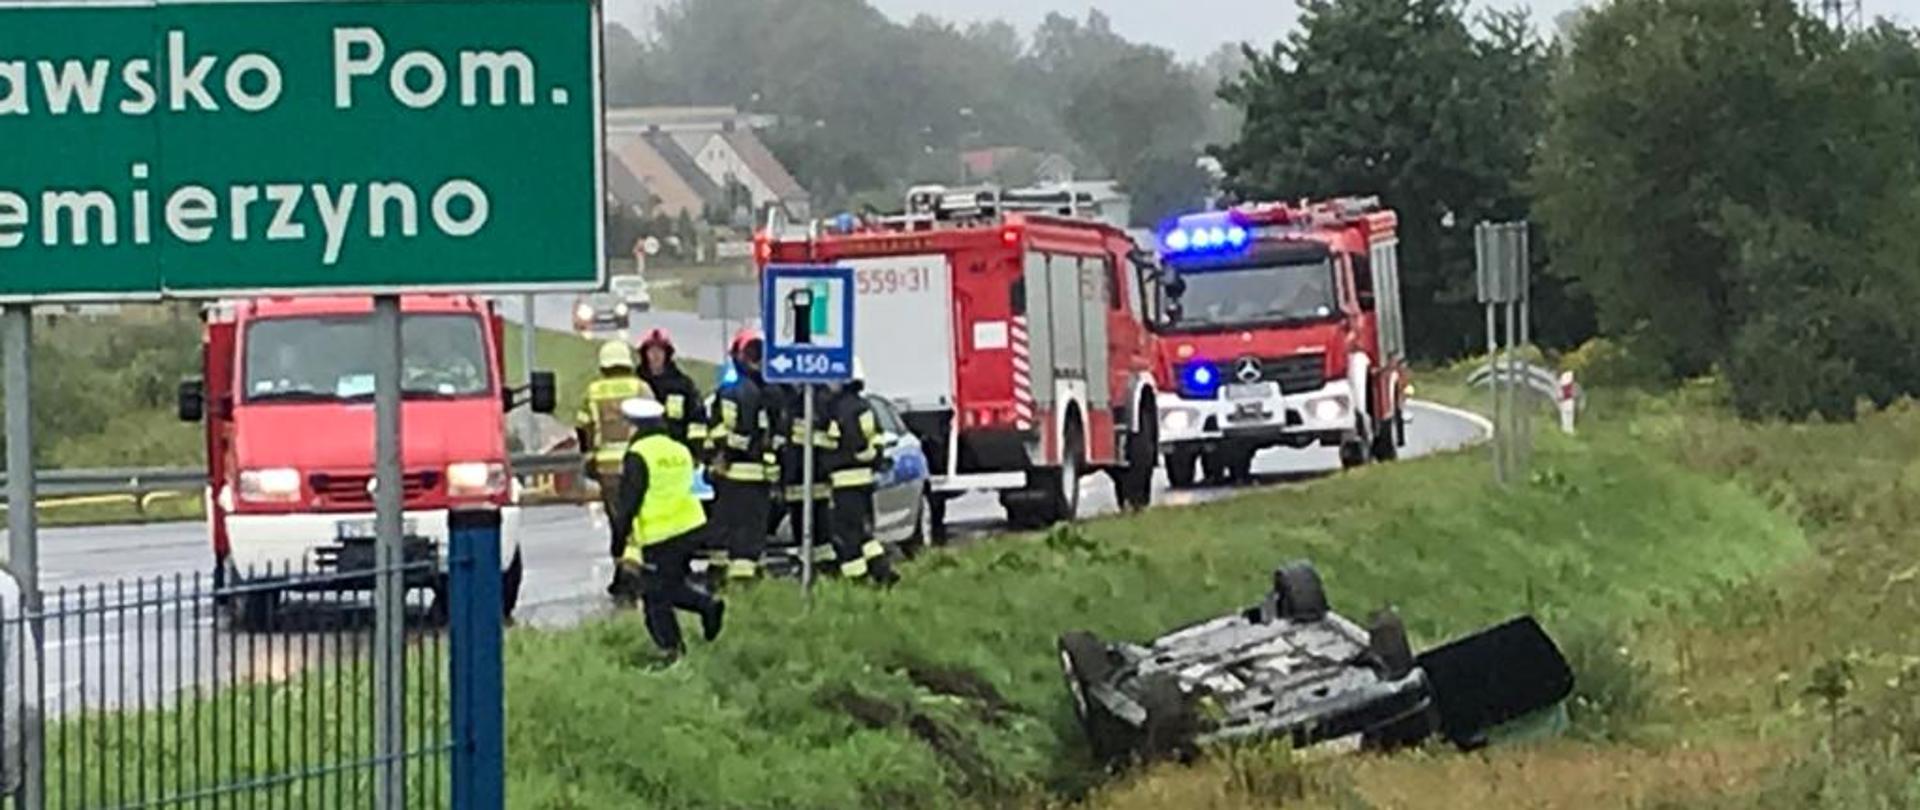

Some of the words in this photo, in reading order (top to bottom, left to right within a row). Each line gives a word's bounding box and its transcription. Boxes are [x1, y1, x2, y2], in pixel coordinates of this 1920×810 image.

[0, 32, 281, 114] awsko
[335, 28, 567, 107] Pom.
[0, 164, 487, 263] emierzyno
[796, 354, 829, 374] 150
